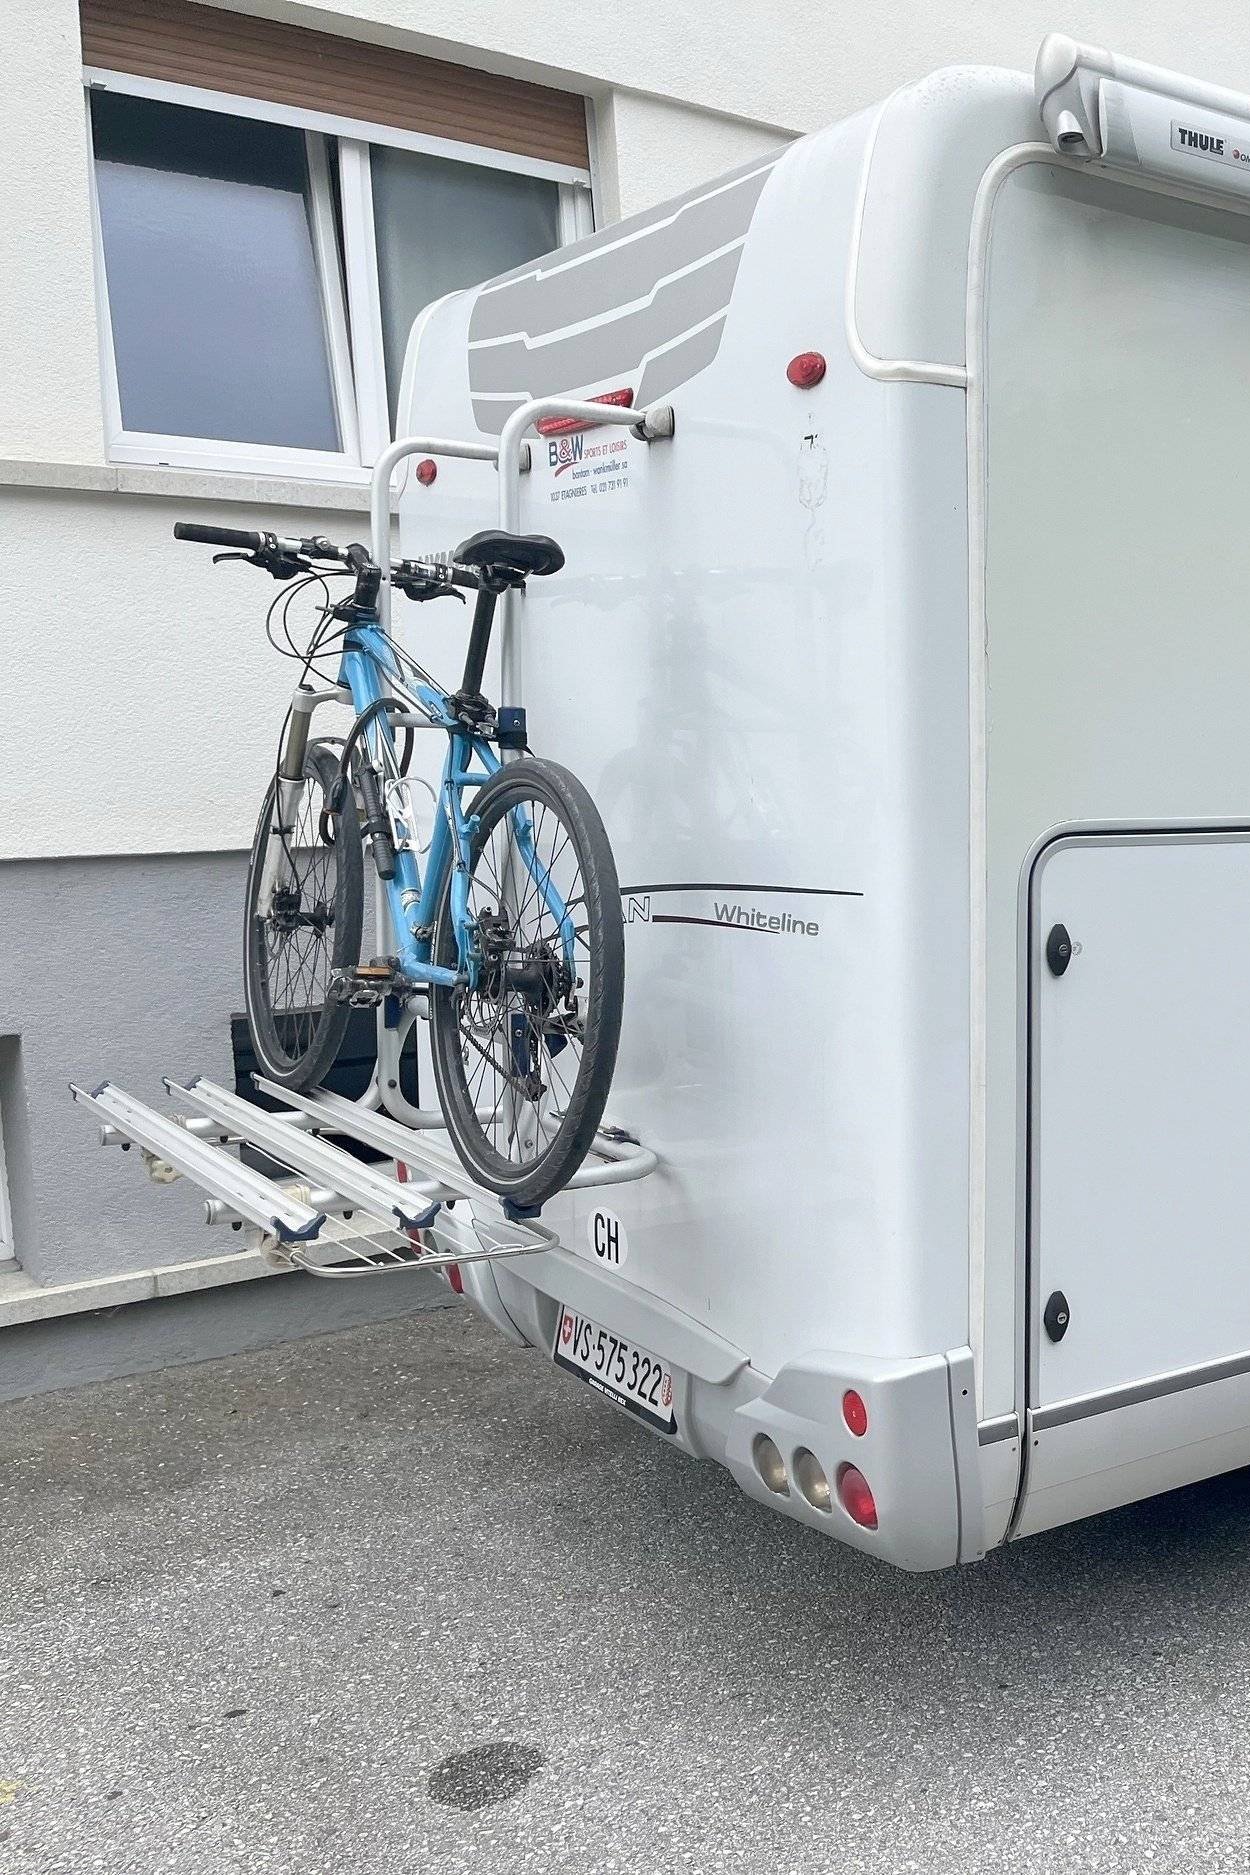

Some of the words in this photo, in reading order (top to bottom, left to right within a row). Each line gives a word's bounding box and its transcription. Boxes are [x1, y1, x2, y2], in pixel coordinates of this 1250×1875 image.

[1178, 127, 1224, 156] THULE
[548, 434, 583, 467] B&W
[584, 446, 601, 460] SPORTS
[602, 444, 608, 456] ET
[609, 440, 627, 454] LOISIRS
[713, 902, 819, 936] Whiteline
[594, 1213, 620, 1264] CH
